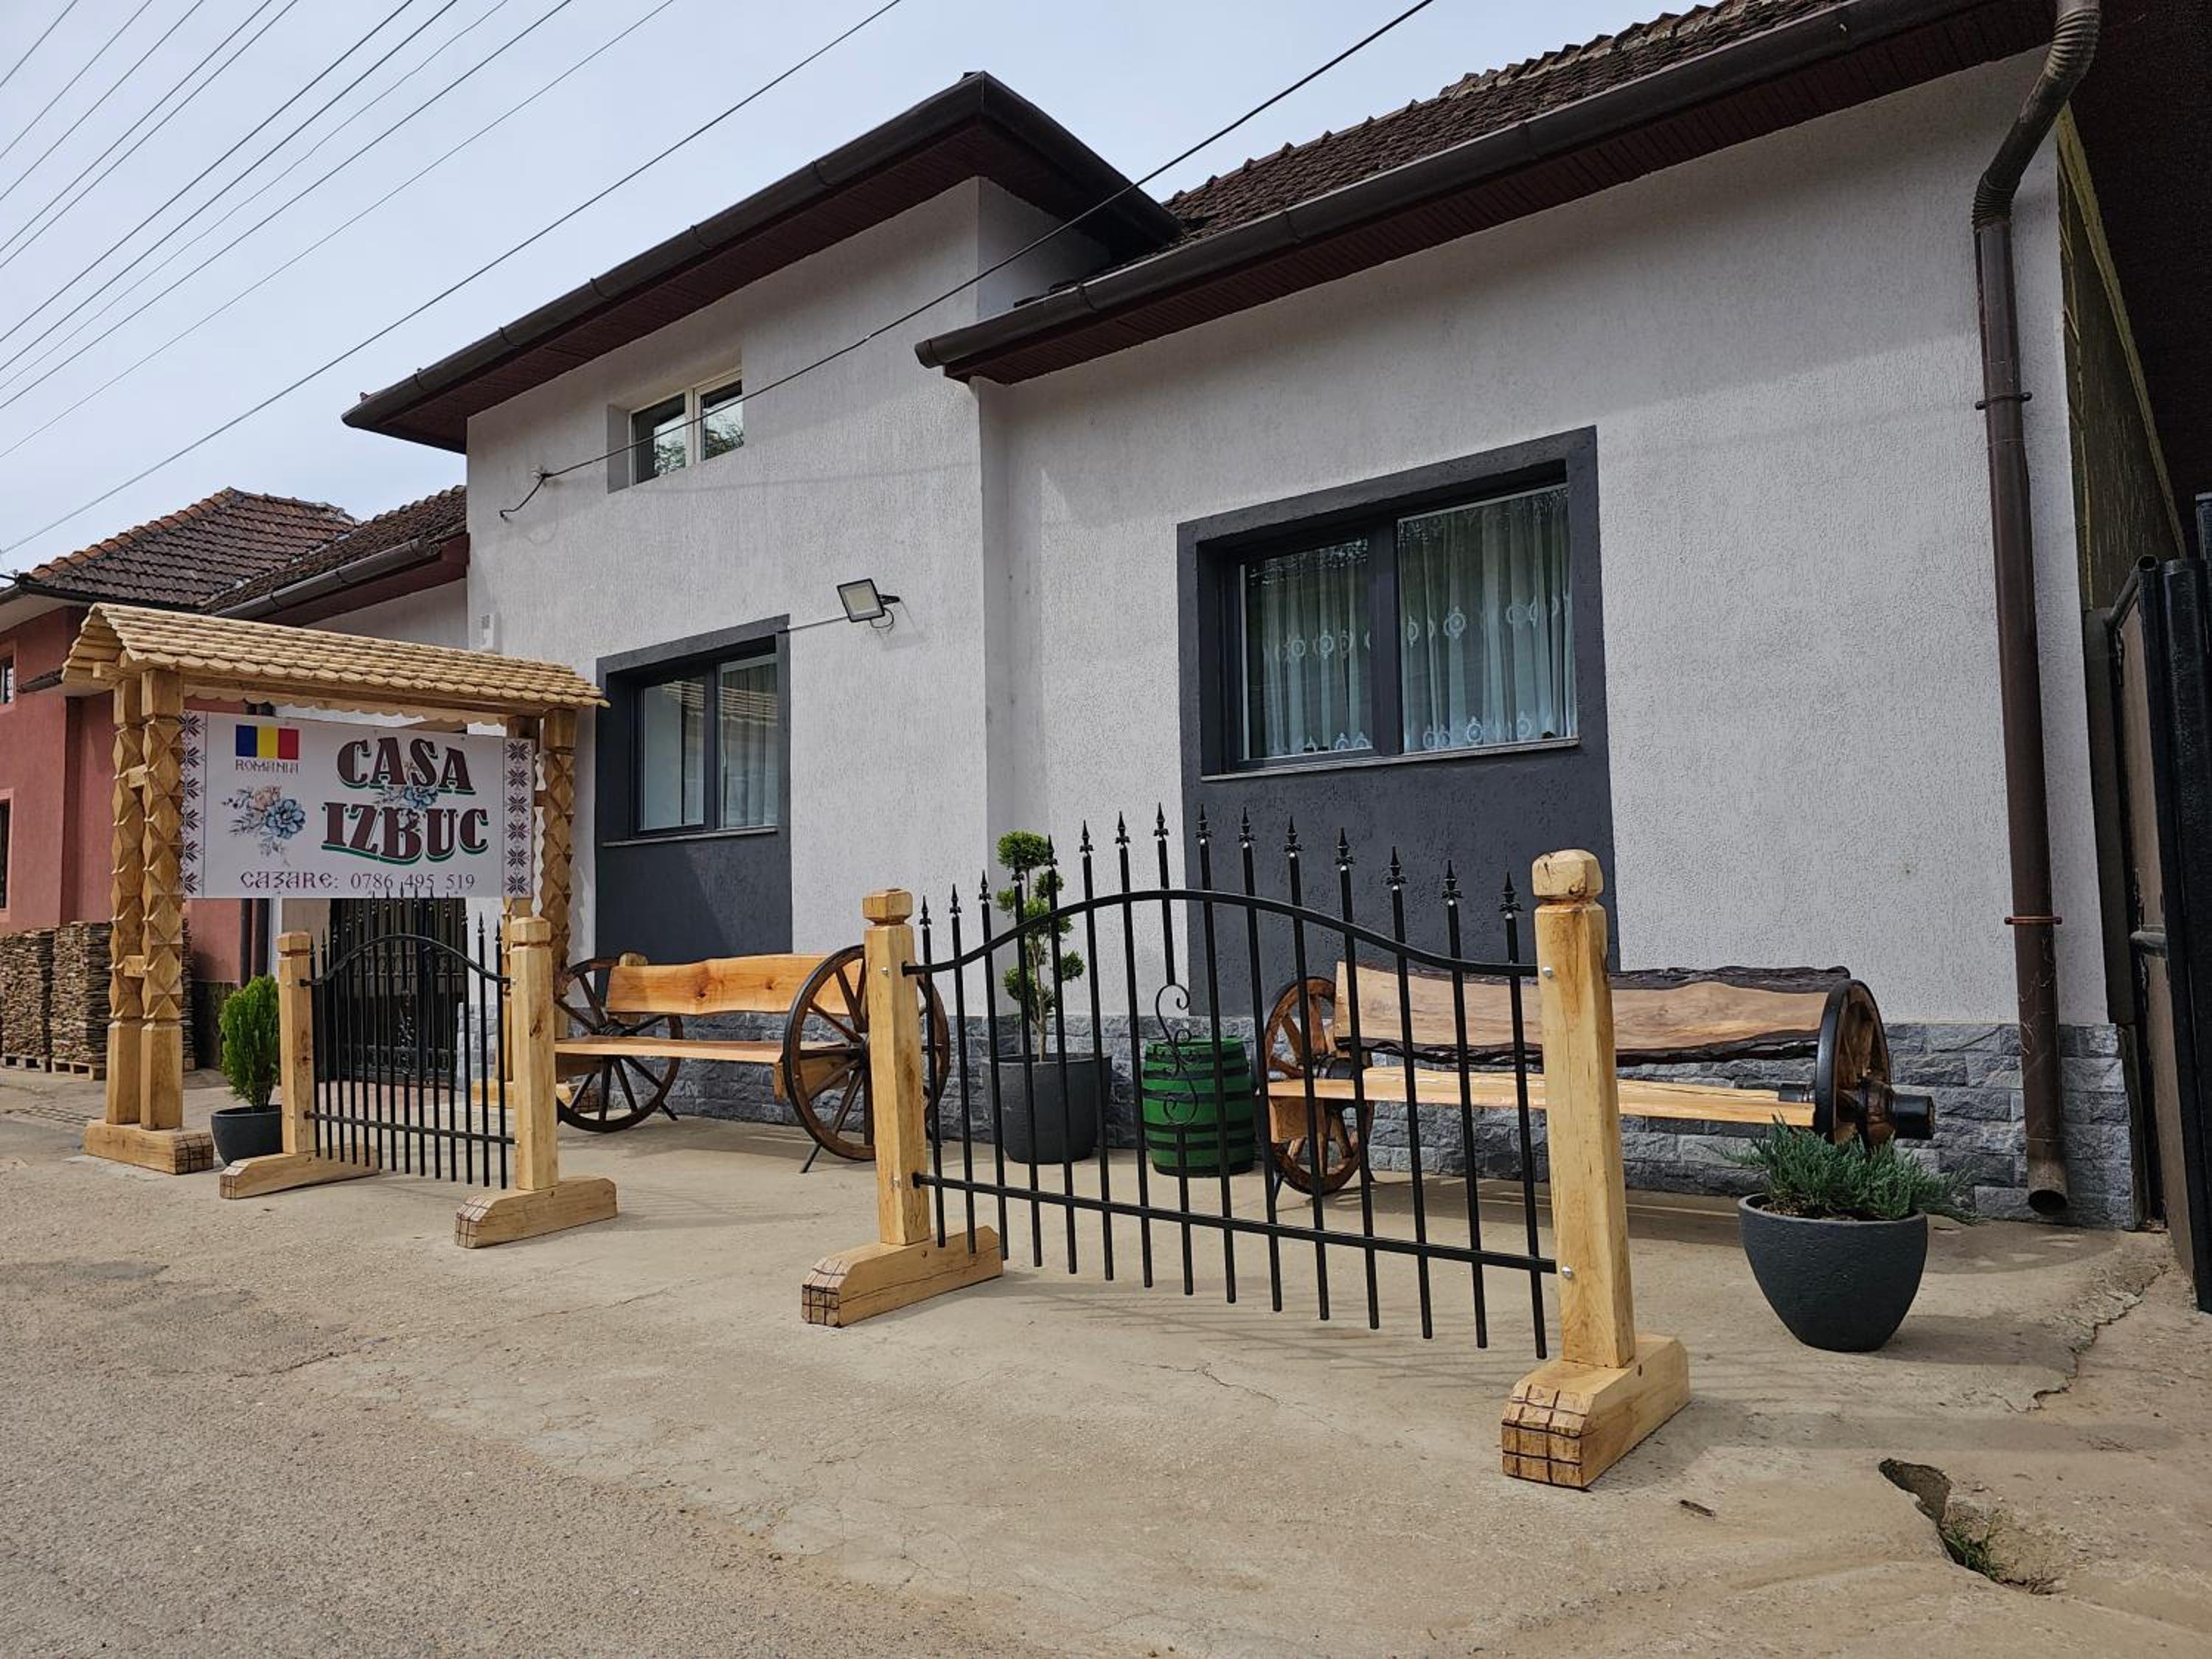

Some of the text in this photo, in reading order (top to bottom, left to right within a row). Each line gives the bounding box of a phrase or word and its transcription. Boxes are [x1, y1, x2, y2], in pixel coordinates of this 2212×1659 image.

[337, 737, 476, 795] CASA
[321, 801, 488, 866] IZBUC
[350, 872, 394, 890] 0786
[404, 873, 435, 890] 495
[445, 874, 475, 890] 519
